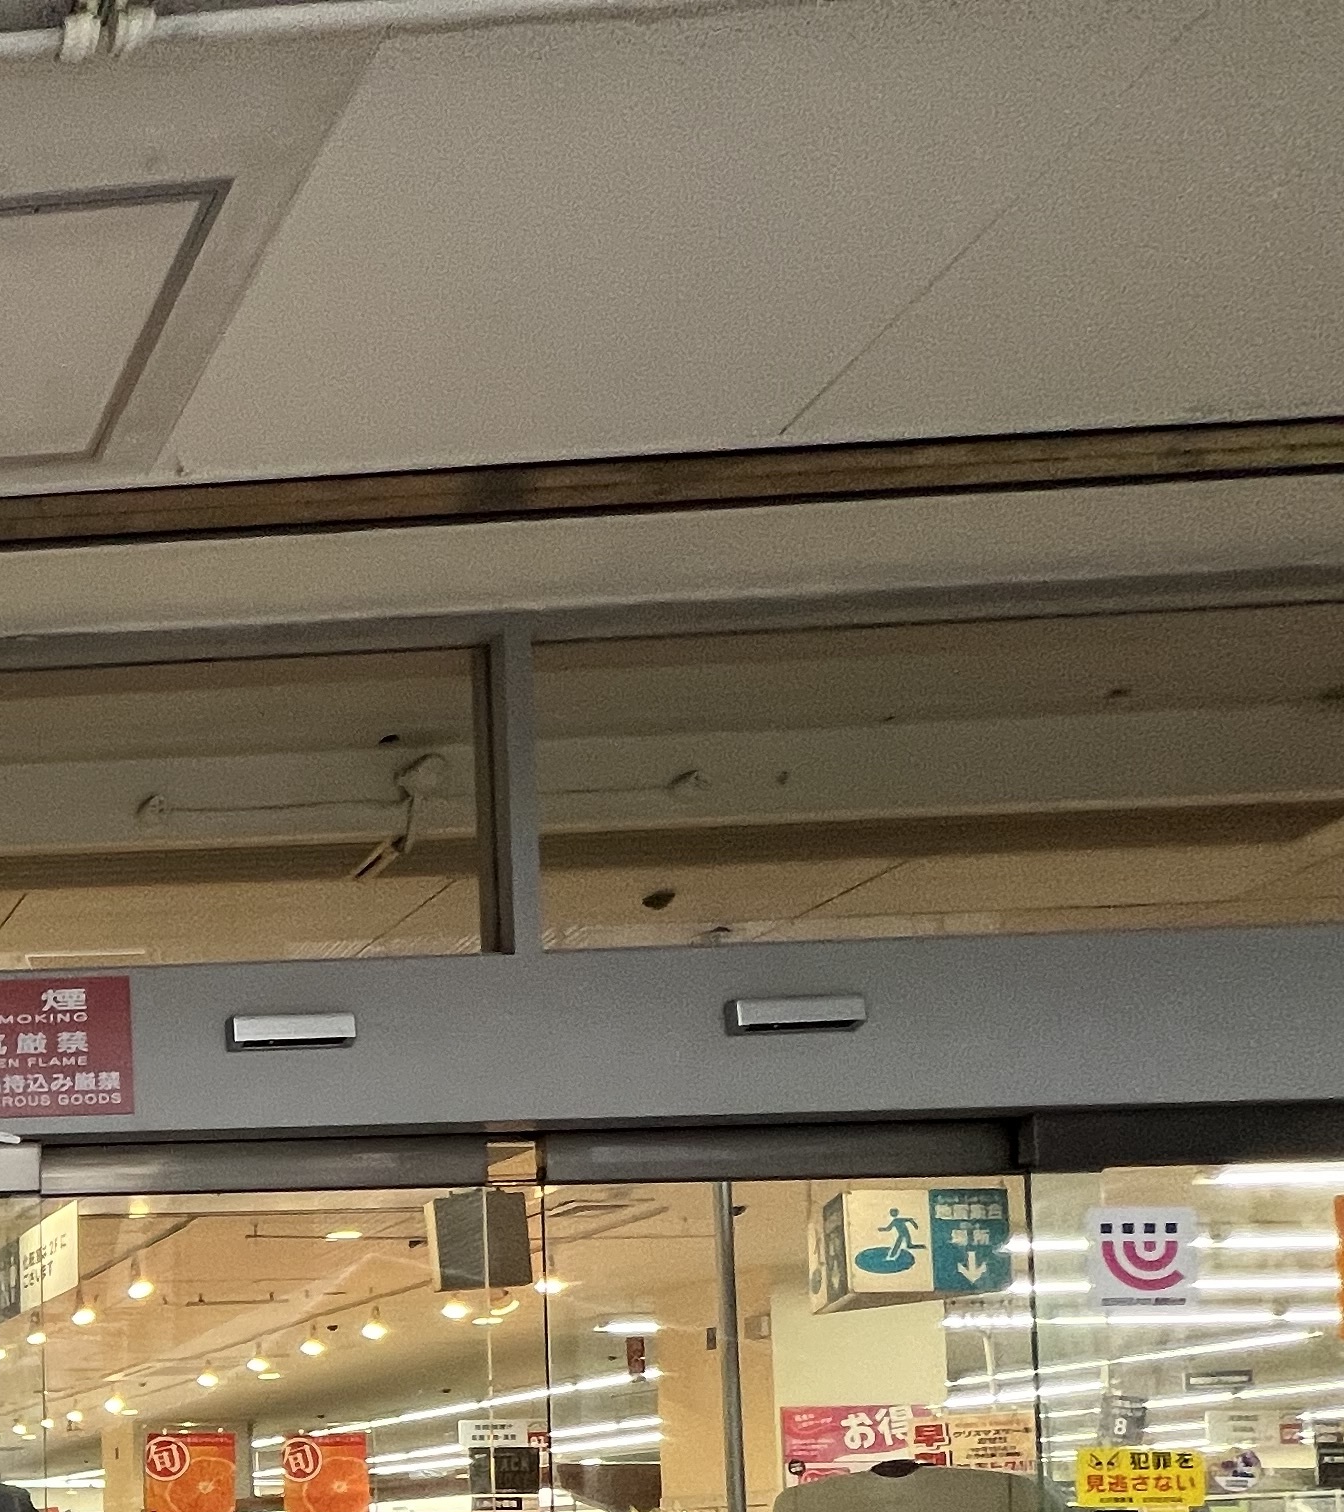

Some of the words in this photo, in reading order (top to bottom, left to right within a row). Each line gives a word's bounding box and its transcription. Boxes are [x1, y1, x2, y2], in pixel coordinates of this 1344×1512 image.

[26, 1054, 88, 1068] FLAME
[57, 1092, 122, 1106] GOODS
[1130, 1452, 1195, 1470] 犯罪を
[1086, 1474, 1196, 1493] 見逃さない
